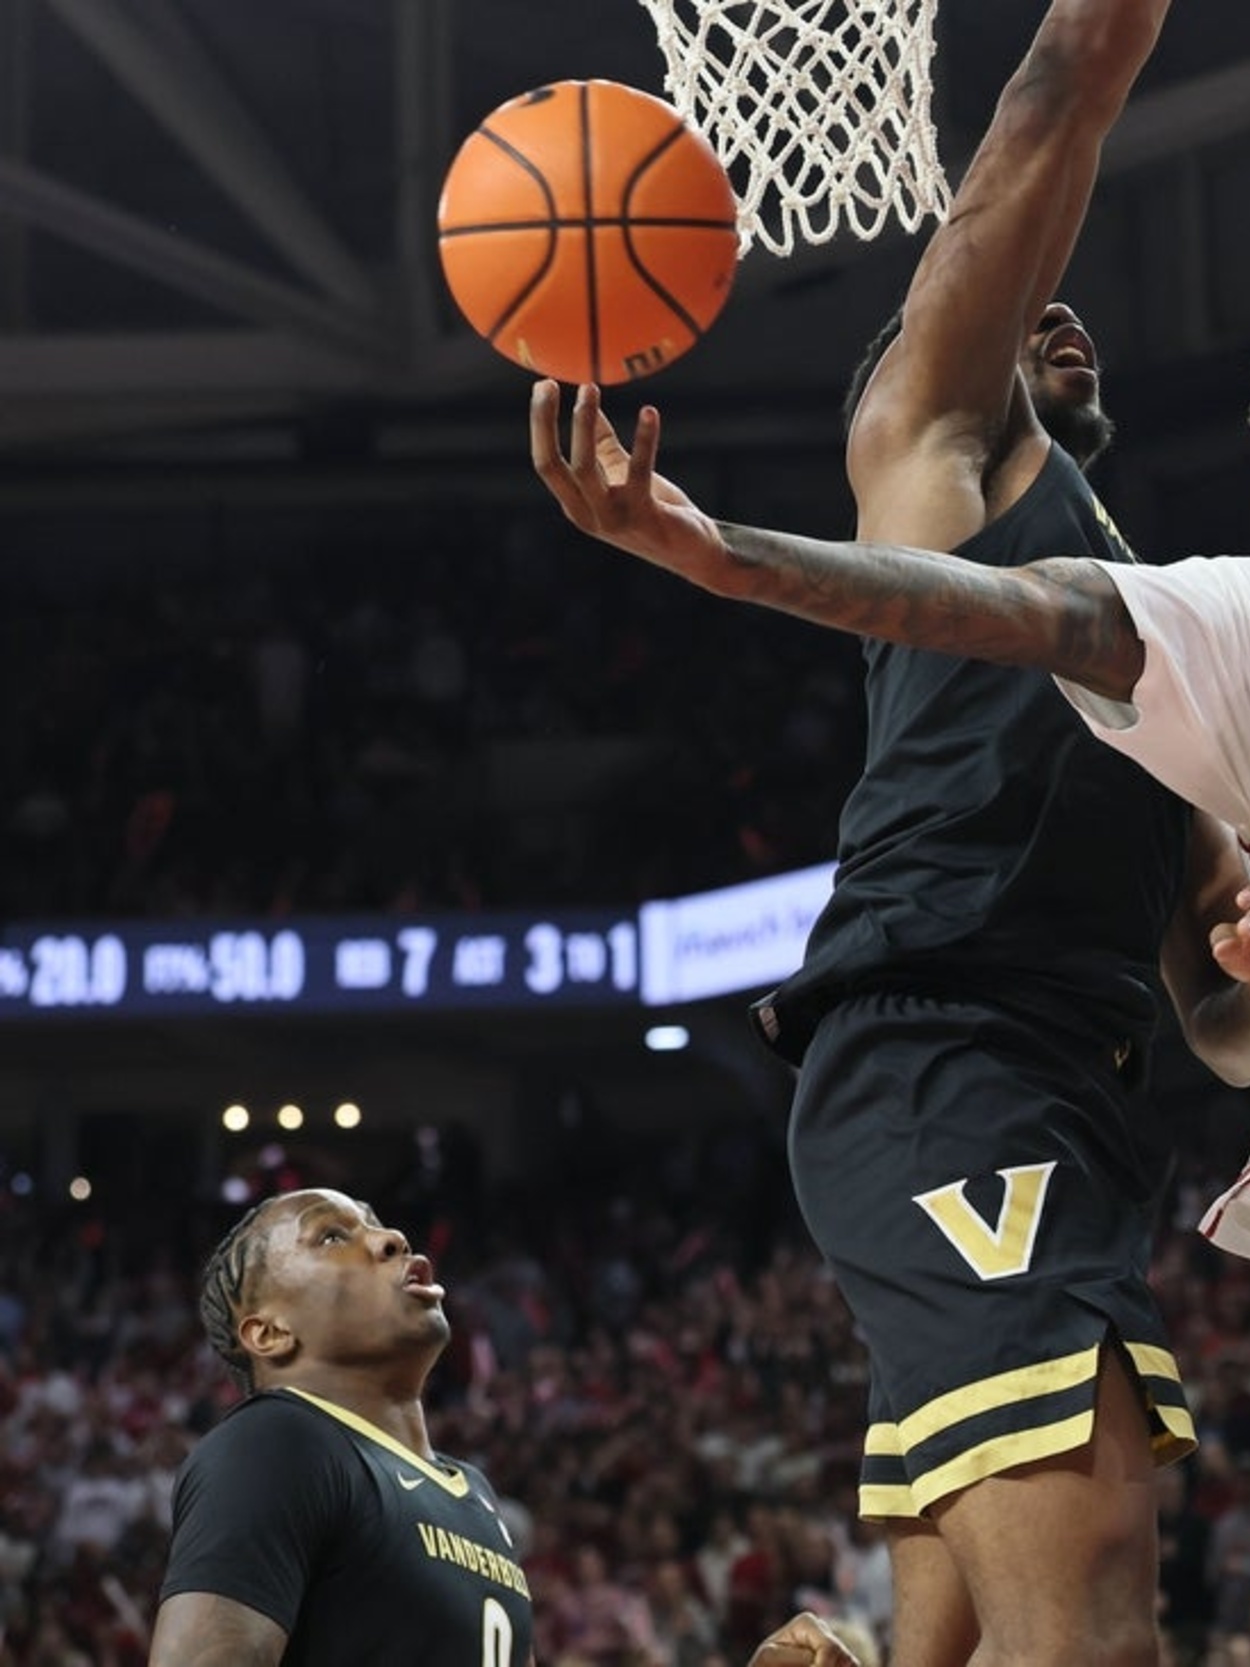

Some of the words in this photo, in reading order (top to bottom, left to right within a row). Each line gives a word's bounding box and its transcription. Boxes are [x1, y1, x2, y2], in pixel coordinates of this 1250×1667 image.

[30, 934, 126, 1006] 20.0
[397, 926, 437, 997] 7
[525, 922, 563, 994] 3
[608, 921, 637, 991] 1
[911, 1160, 1058, 1281] V
